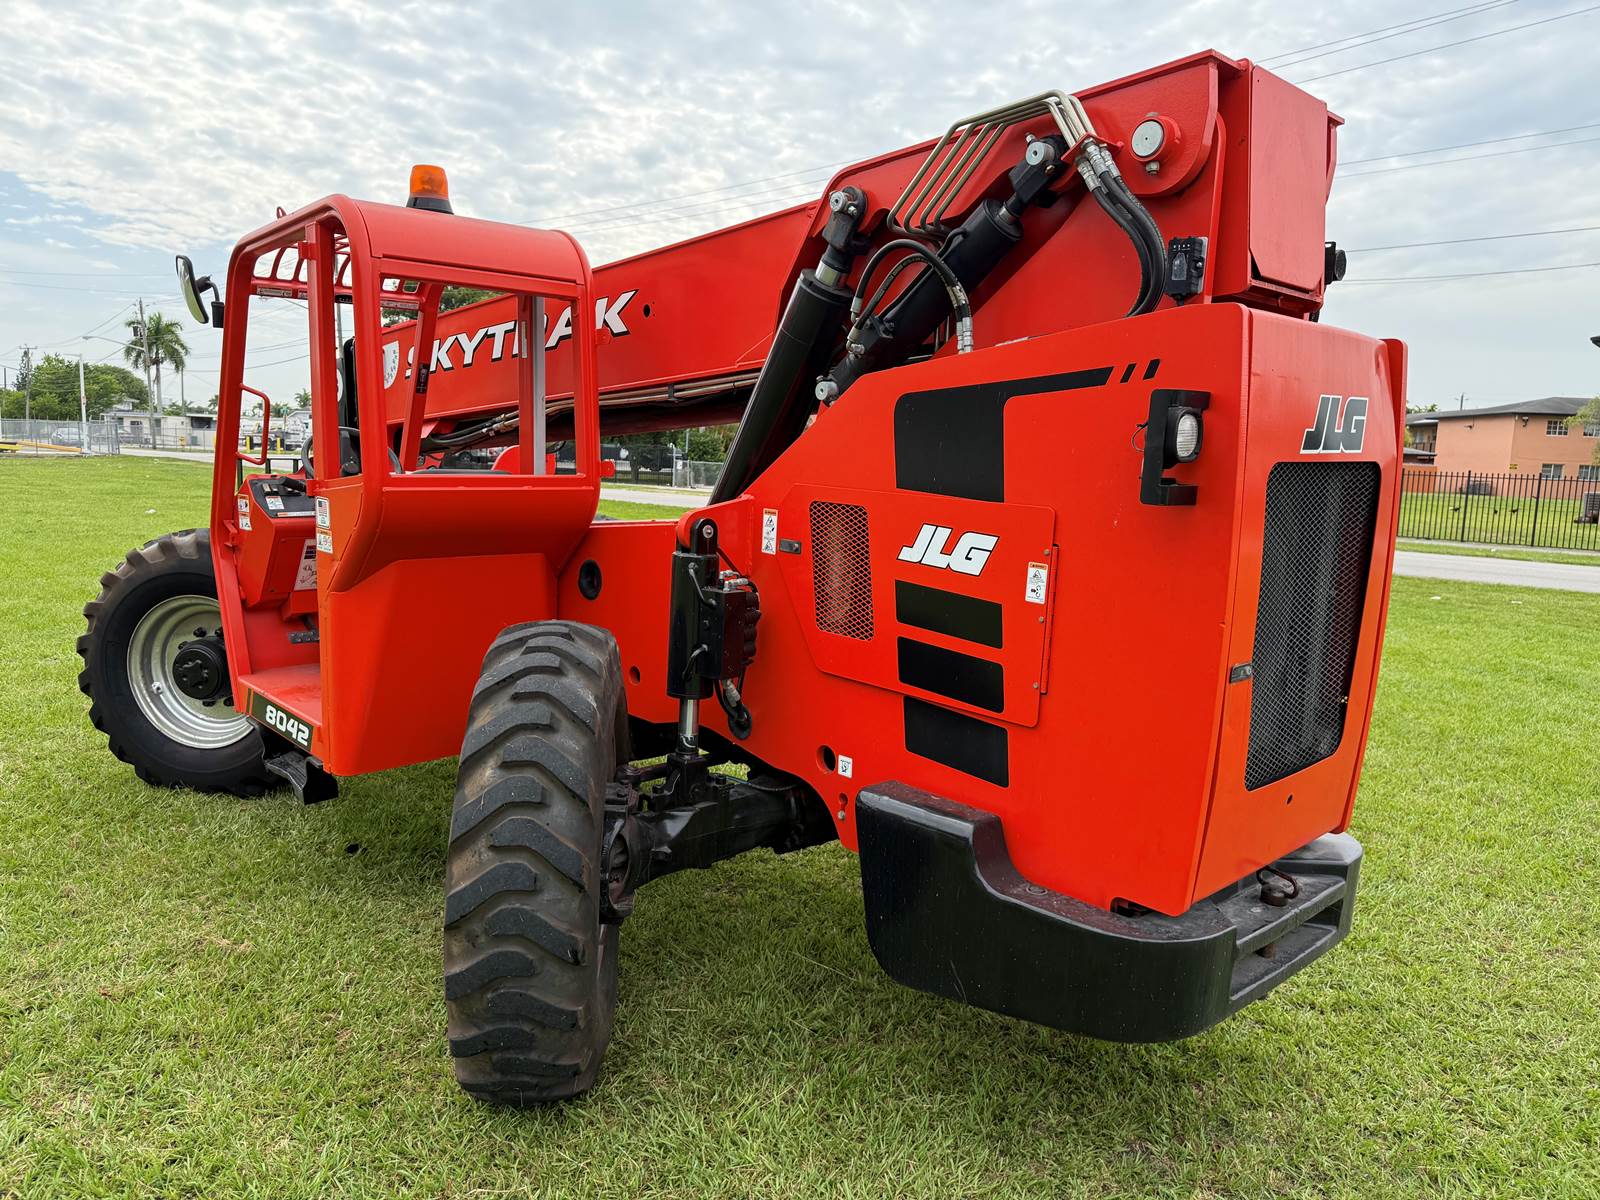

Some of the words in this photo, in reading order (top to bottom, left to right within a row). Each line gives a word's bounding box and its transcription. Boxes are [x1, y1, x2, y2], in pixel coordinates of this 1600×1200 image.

[1299, 394, 1369, 454] JLG
[897, 523, 1000, 577] JLG
[265, 704, 309, 747] 8042
